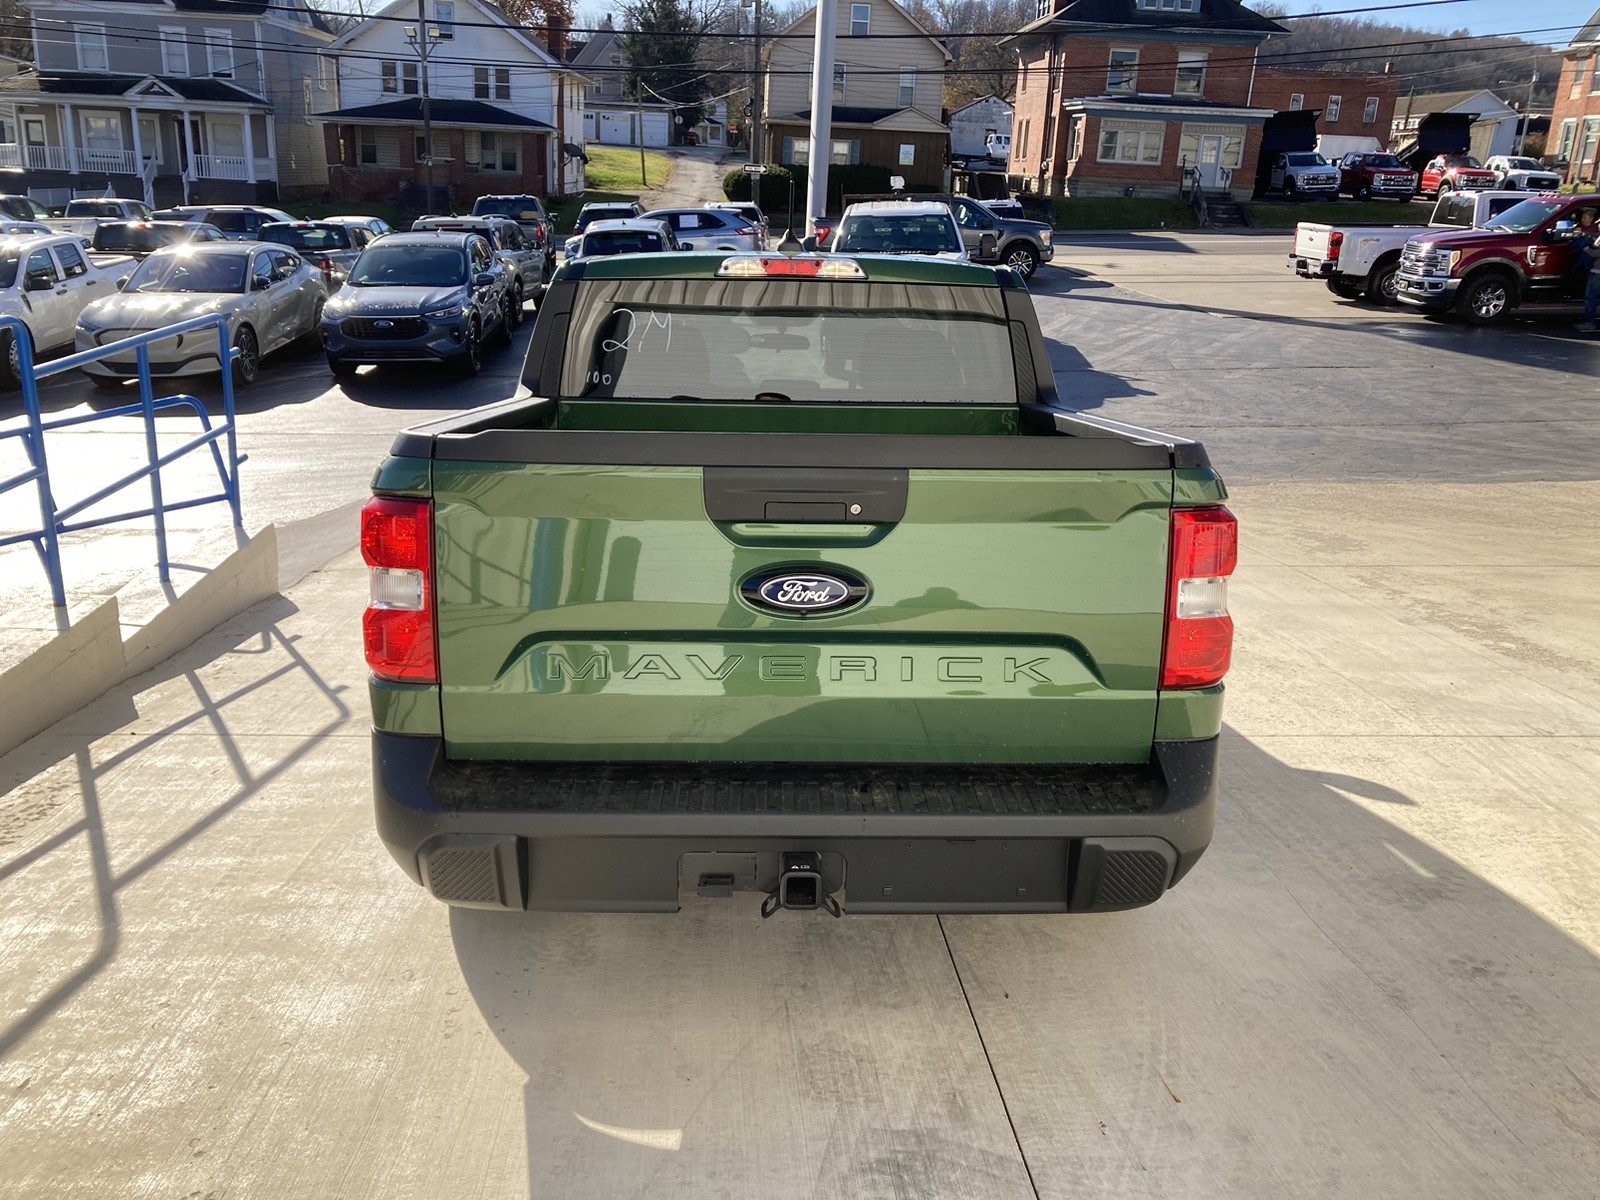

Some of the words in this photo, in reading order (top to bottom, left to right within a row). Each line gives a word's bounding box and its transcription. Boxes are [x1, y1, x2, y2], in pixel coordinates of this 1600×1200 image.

[586, 370, 612, 386] 100
[777, 579, 830, 602] Ford
[546, 653, 1055, 683] MAVERICK
